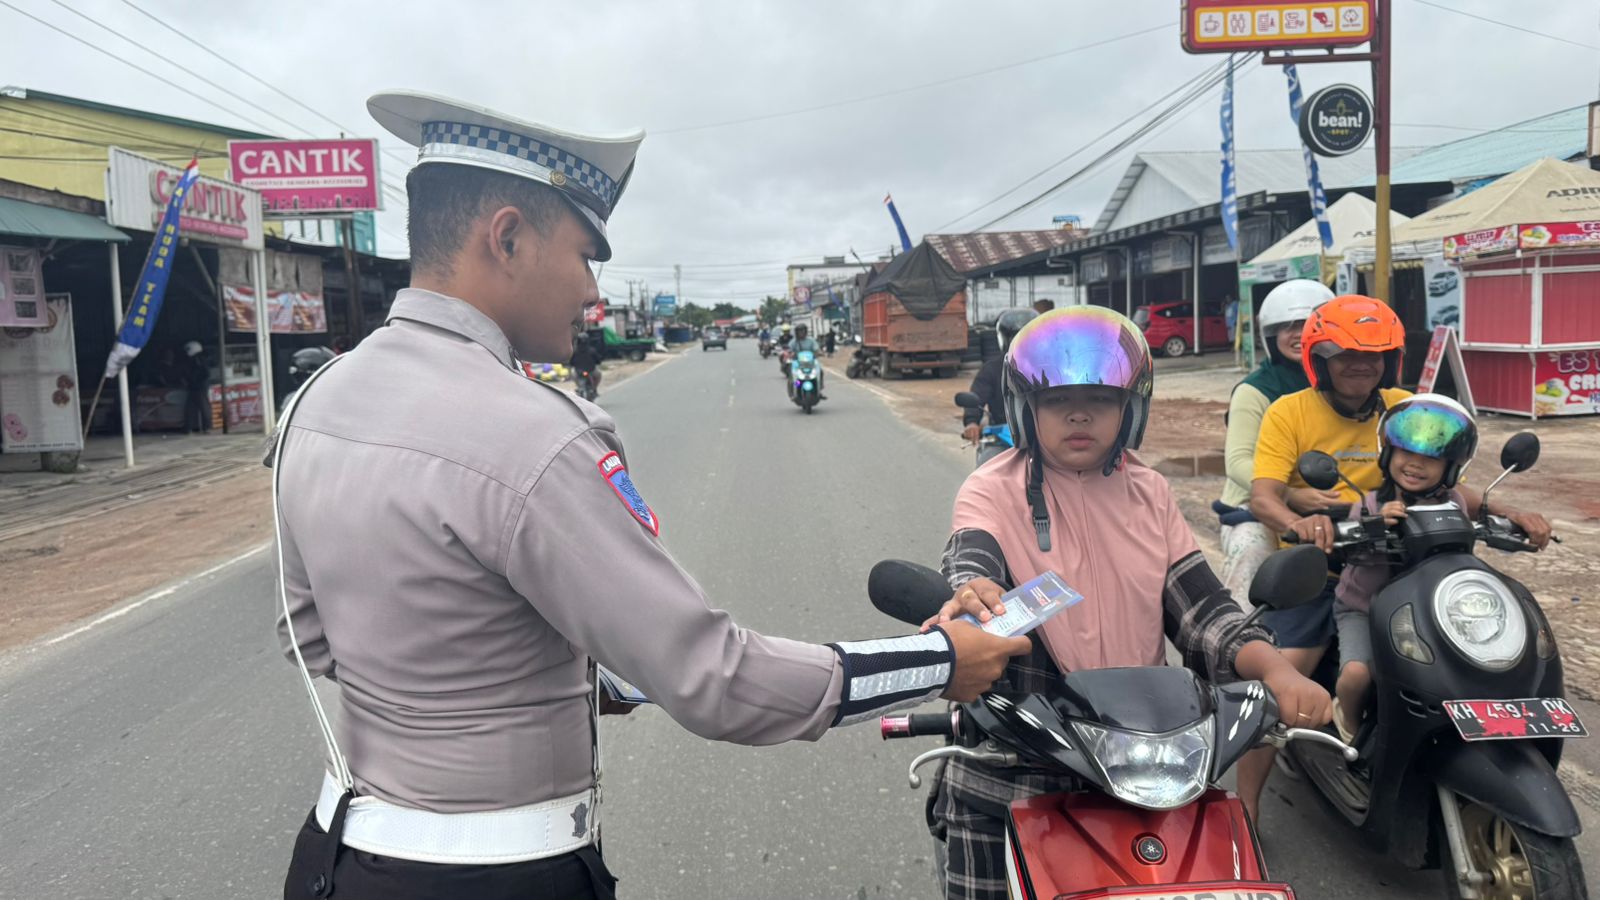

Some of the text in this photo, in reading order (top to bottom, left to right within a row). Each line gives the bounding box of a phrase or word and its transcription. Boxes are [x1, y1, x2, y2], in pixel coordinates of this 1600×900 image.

[1318, 110, 1363, 128] bean!
[238, 148, 365, 175] CANTIK
[150, 168, 248, 222] CNTIK
[1558, 351, 1589, 373] ES
[1450, 702, 1478, 720] KH
